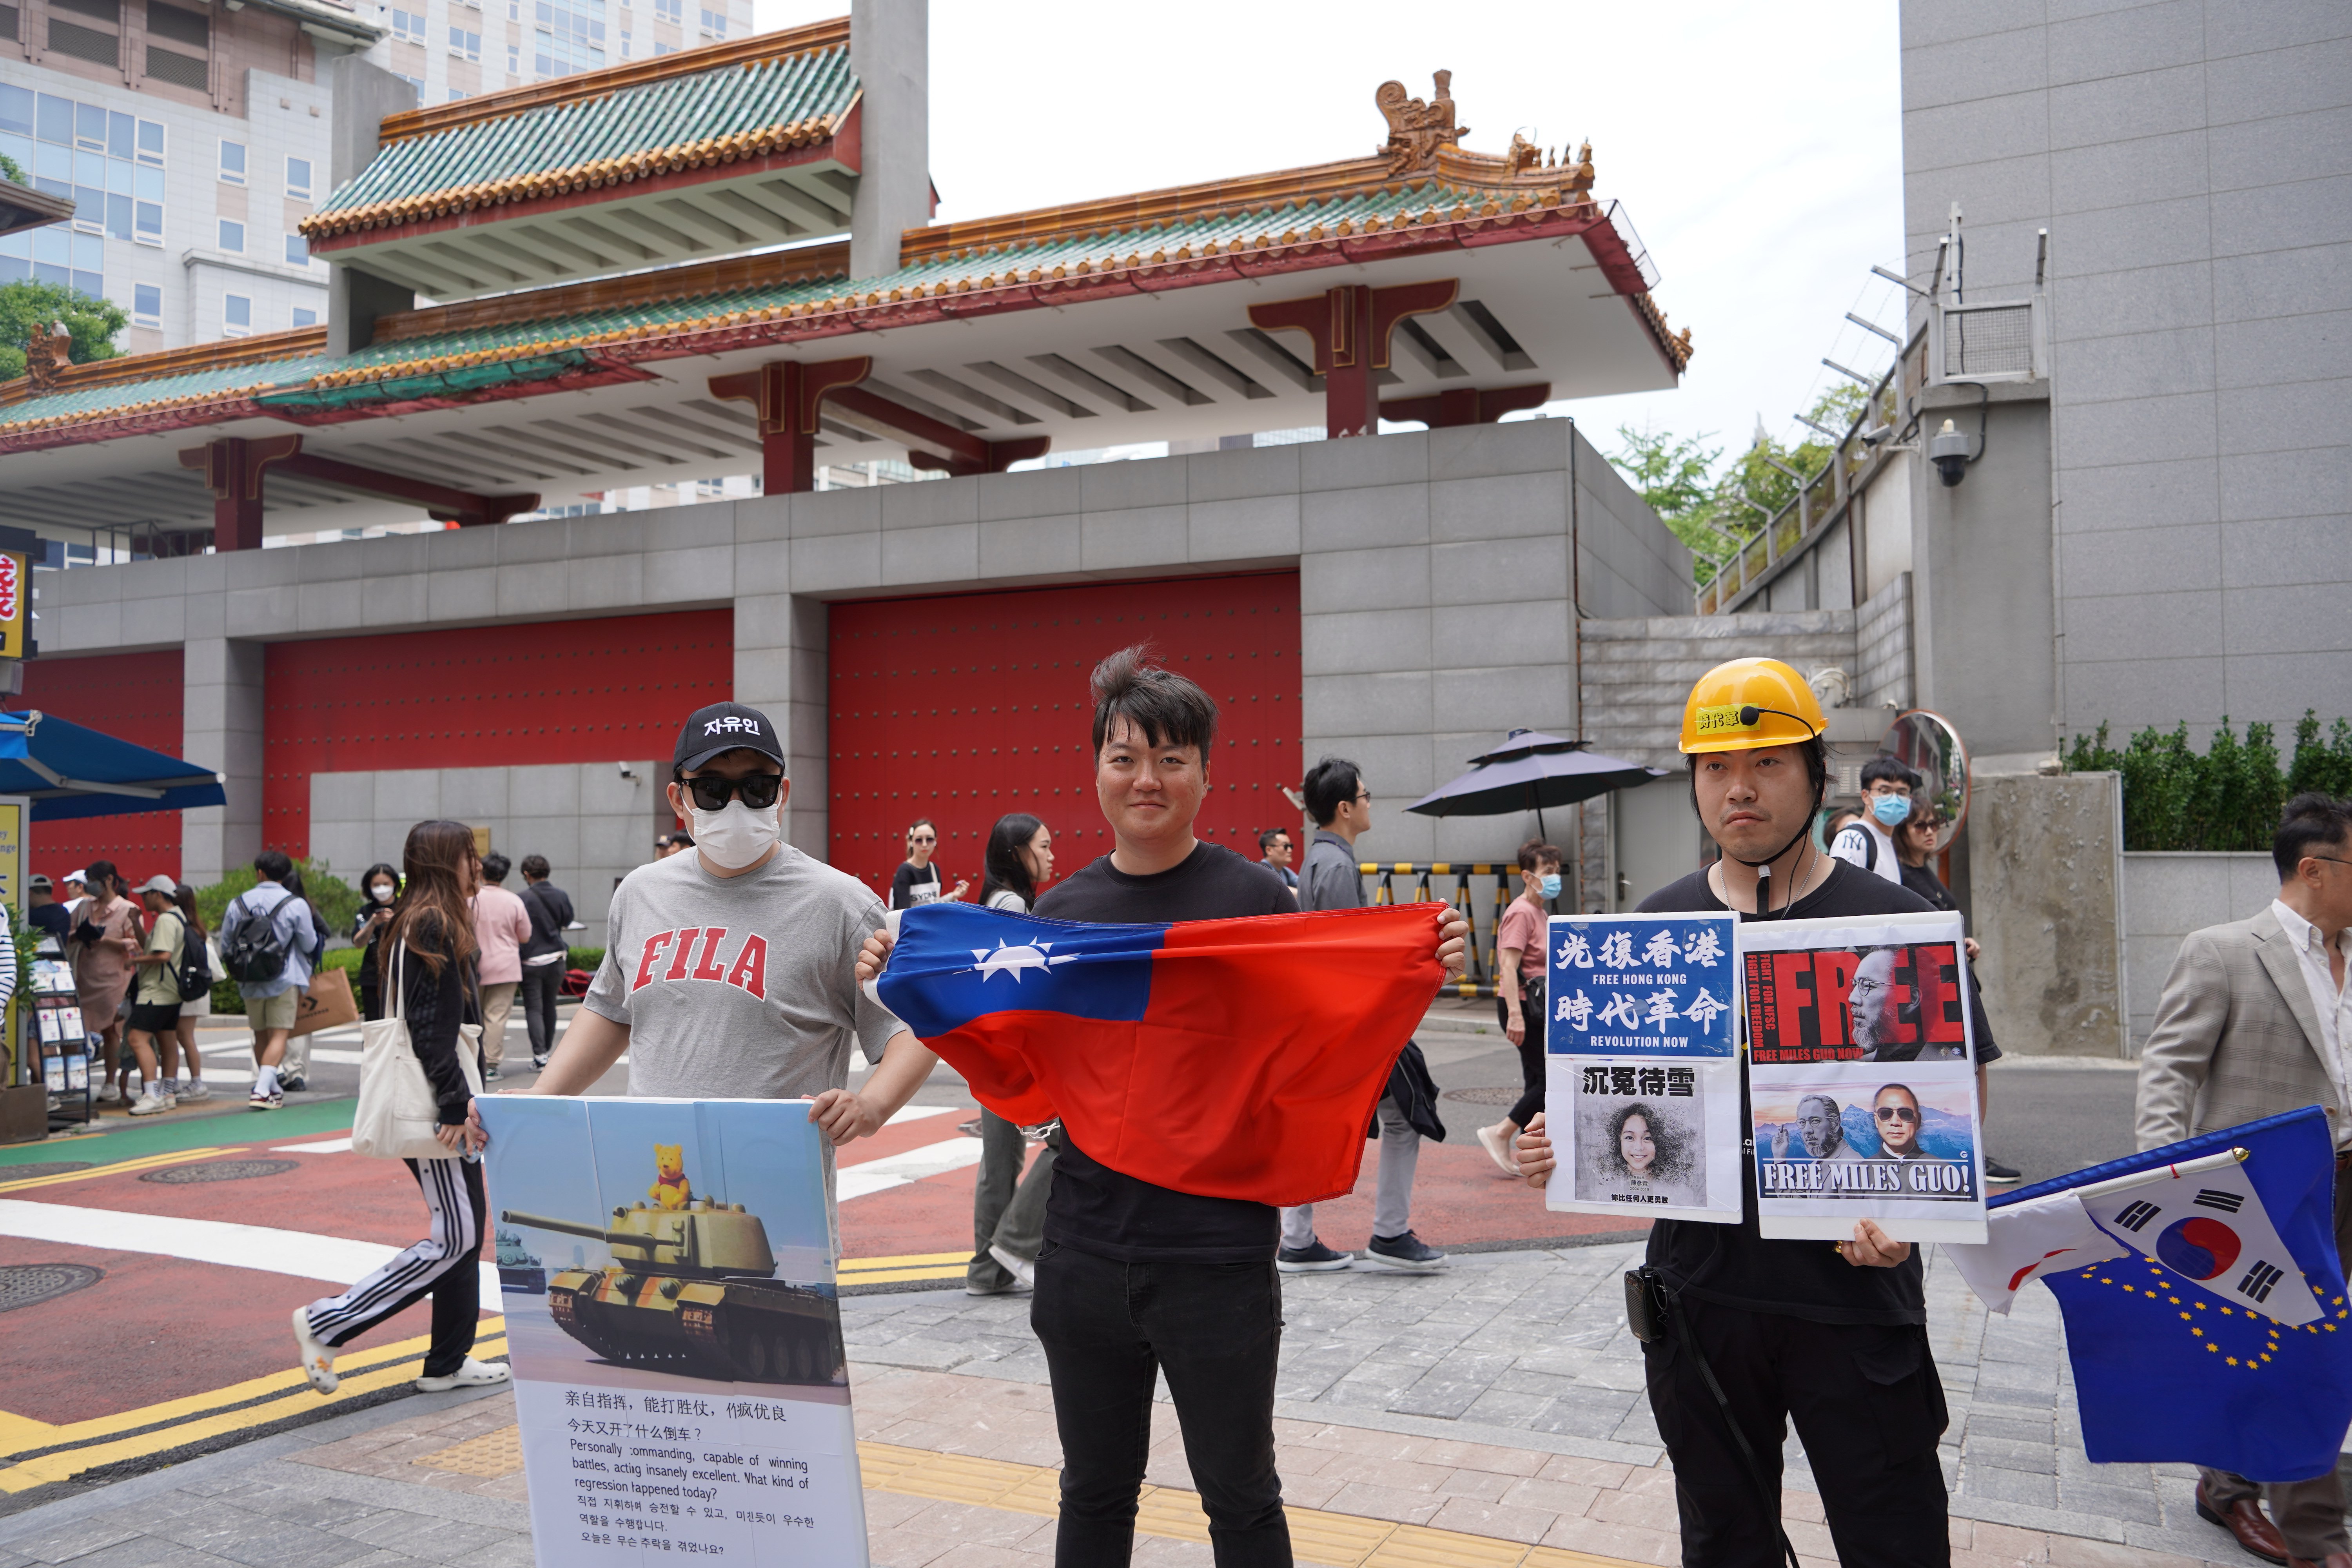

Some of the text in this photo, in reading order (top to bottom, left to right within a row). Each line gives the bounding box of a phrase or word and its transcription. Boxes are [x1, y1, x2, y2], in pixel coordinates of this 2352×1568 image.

[704, 717, 760, 736] 자유인
[1699, 711, 1744, 729] 時代革
[1555, 927, 1726, 969] 光復香港
[631, 926, 769, 1002] FILA
[1593, 974, 1687, 985] FREE HONG KONG
[1760, 954, 1776, 1030] FIGHT FOR NFSC
[1747, 955, 1764, 1047] FIGHT FOR FREEDOM
[1773, 945, 1964, 1046] FREE
[1554, 987, 1730, 1035] 時代革命
[1591, 1036, 1688, 1047] REVOLUTION NOW
[1754, 1047, 1864, 1061] FREE MILES GUO NOW
[1583, 1067, 1695, 1096] 沉冤待雪
[1763, 1164, 1970, 1192] FREE MILES GUO!
[1611, 1194, 1668, 1203] 妳比任何人更勇敢
[570, 1439, 622, 1457] Personally
[704, 1452, 744, 1465] capable
[750, 1455, 759, 1466] of
[769, 1457, 808, 1473] winning
[572, 1457, 609, 1473] battles,
[646, 1464, 687, 1481] insanely
[692, 1470, 740, 1483] excellent.
[772, 1475, 793, 1488] kind
[799, 1478, 809, 1489] of
[575, 1478, 628, 1491] regression
[682, 1486, 717, 1502] today?
[577, 1495, 814, 1528] 직접 지휘하며 승전할 수 있고, 미친듯이 우수한
[580, 1513, 668, 1532] 역할을 수행합니다.
[582, 1532, 724, 1555] 오늘은 무슨 추락을 겪었나요?
